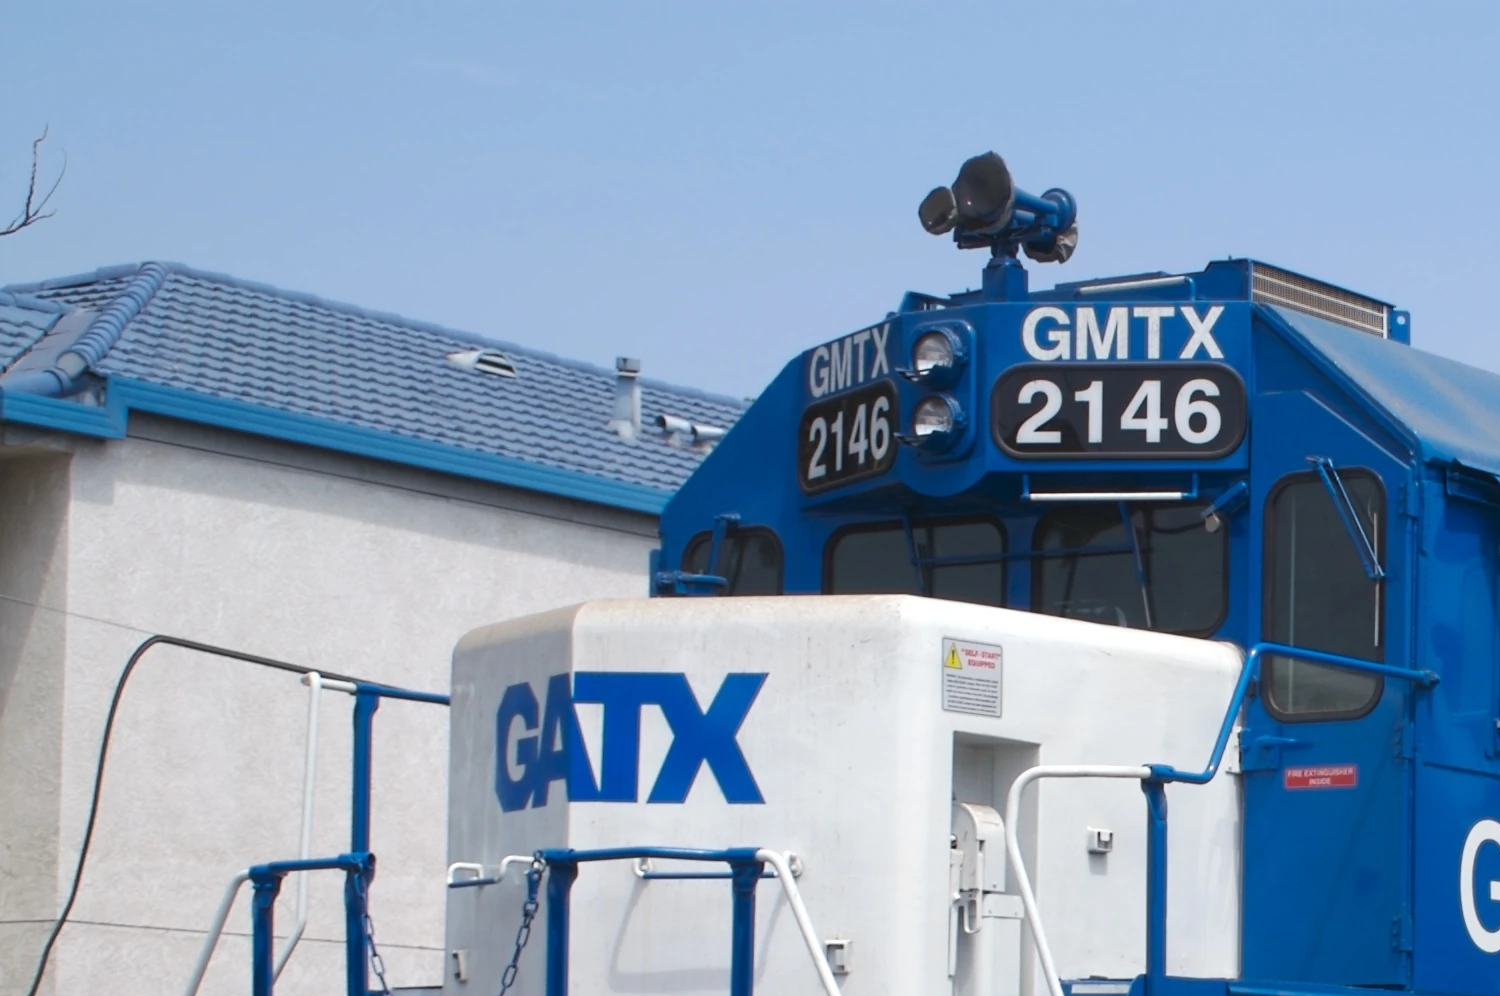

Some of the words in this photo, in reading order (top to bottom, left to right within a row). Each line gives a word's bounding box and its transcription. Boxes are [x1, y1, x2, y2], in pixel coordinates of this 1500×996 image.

[809, 322, 890, 398] GMTX
[1021, 306, 1225, 361] GMTX
[807, 396, 891, 480] 2146
[1015, 379, 1223, 445] 2146
[495, 671, 770, 813] GATX
[1287, 769, 1303, 778] FIRE
